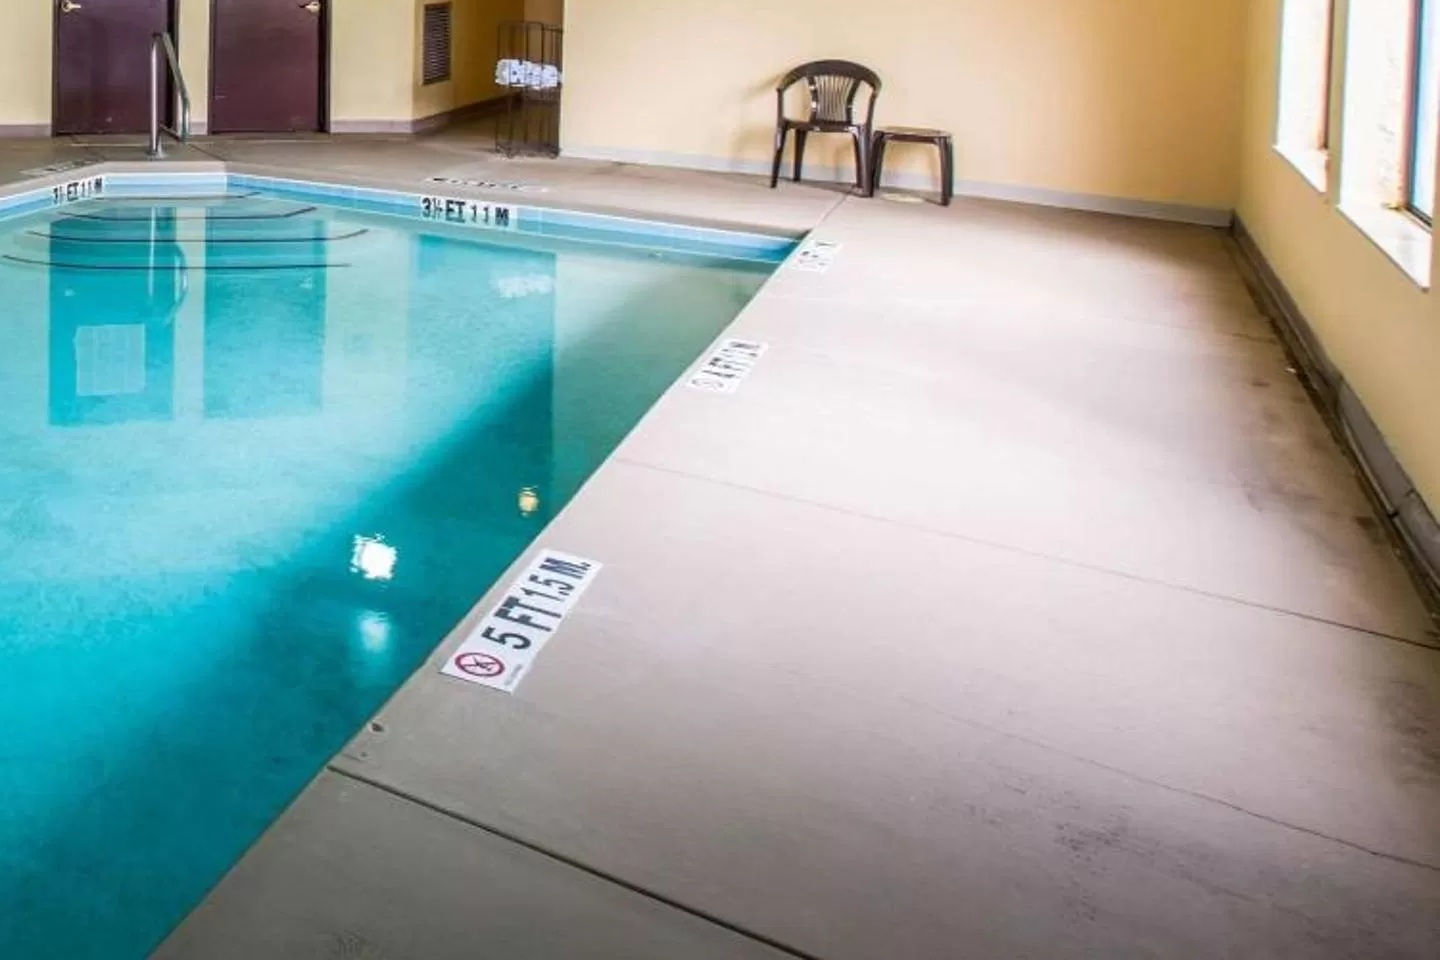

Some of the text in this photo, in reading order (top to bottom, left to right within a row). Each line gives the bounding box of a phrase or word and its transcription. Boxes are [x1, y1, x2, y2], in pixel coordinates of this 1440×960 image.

[495, 207, 509, 226] M
[519, 574, 575, 601] 1.5
[493, 596, 562, 632] FT
[481, 625, 531, 650] 5
